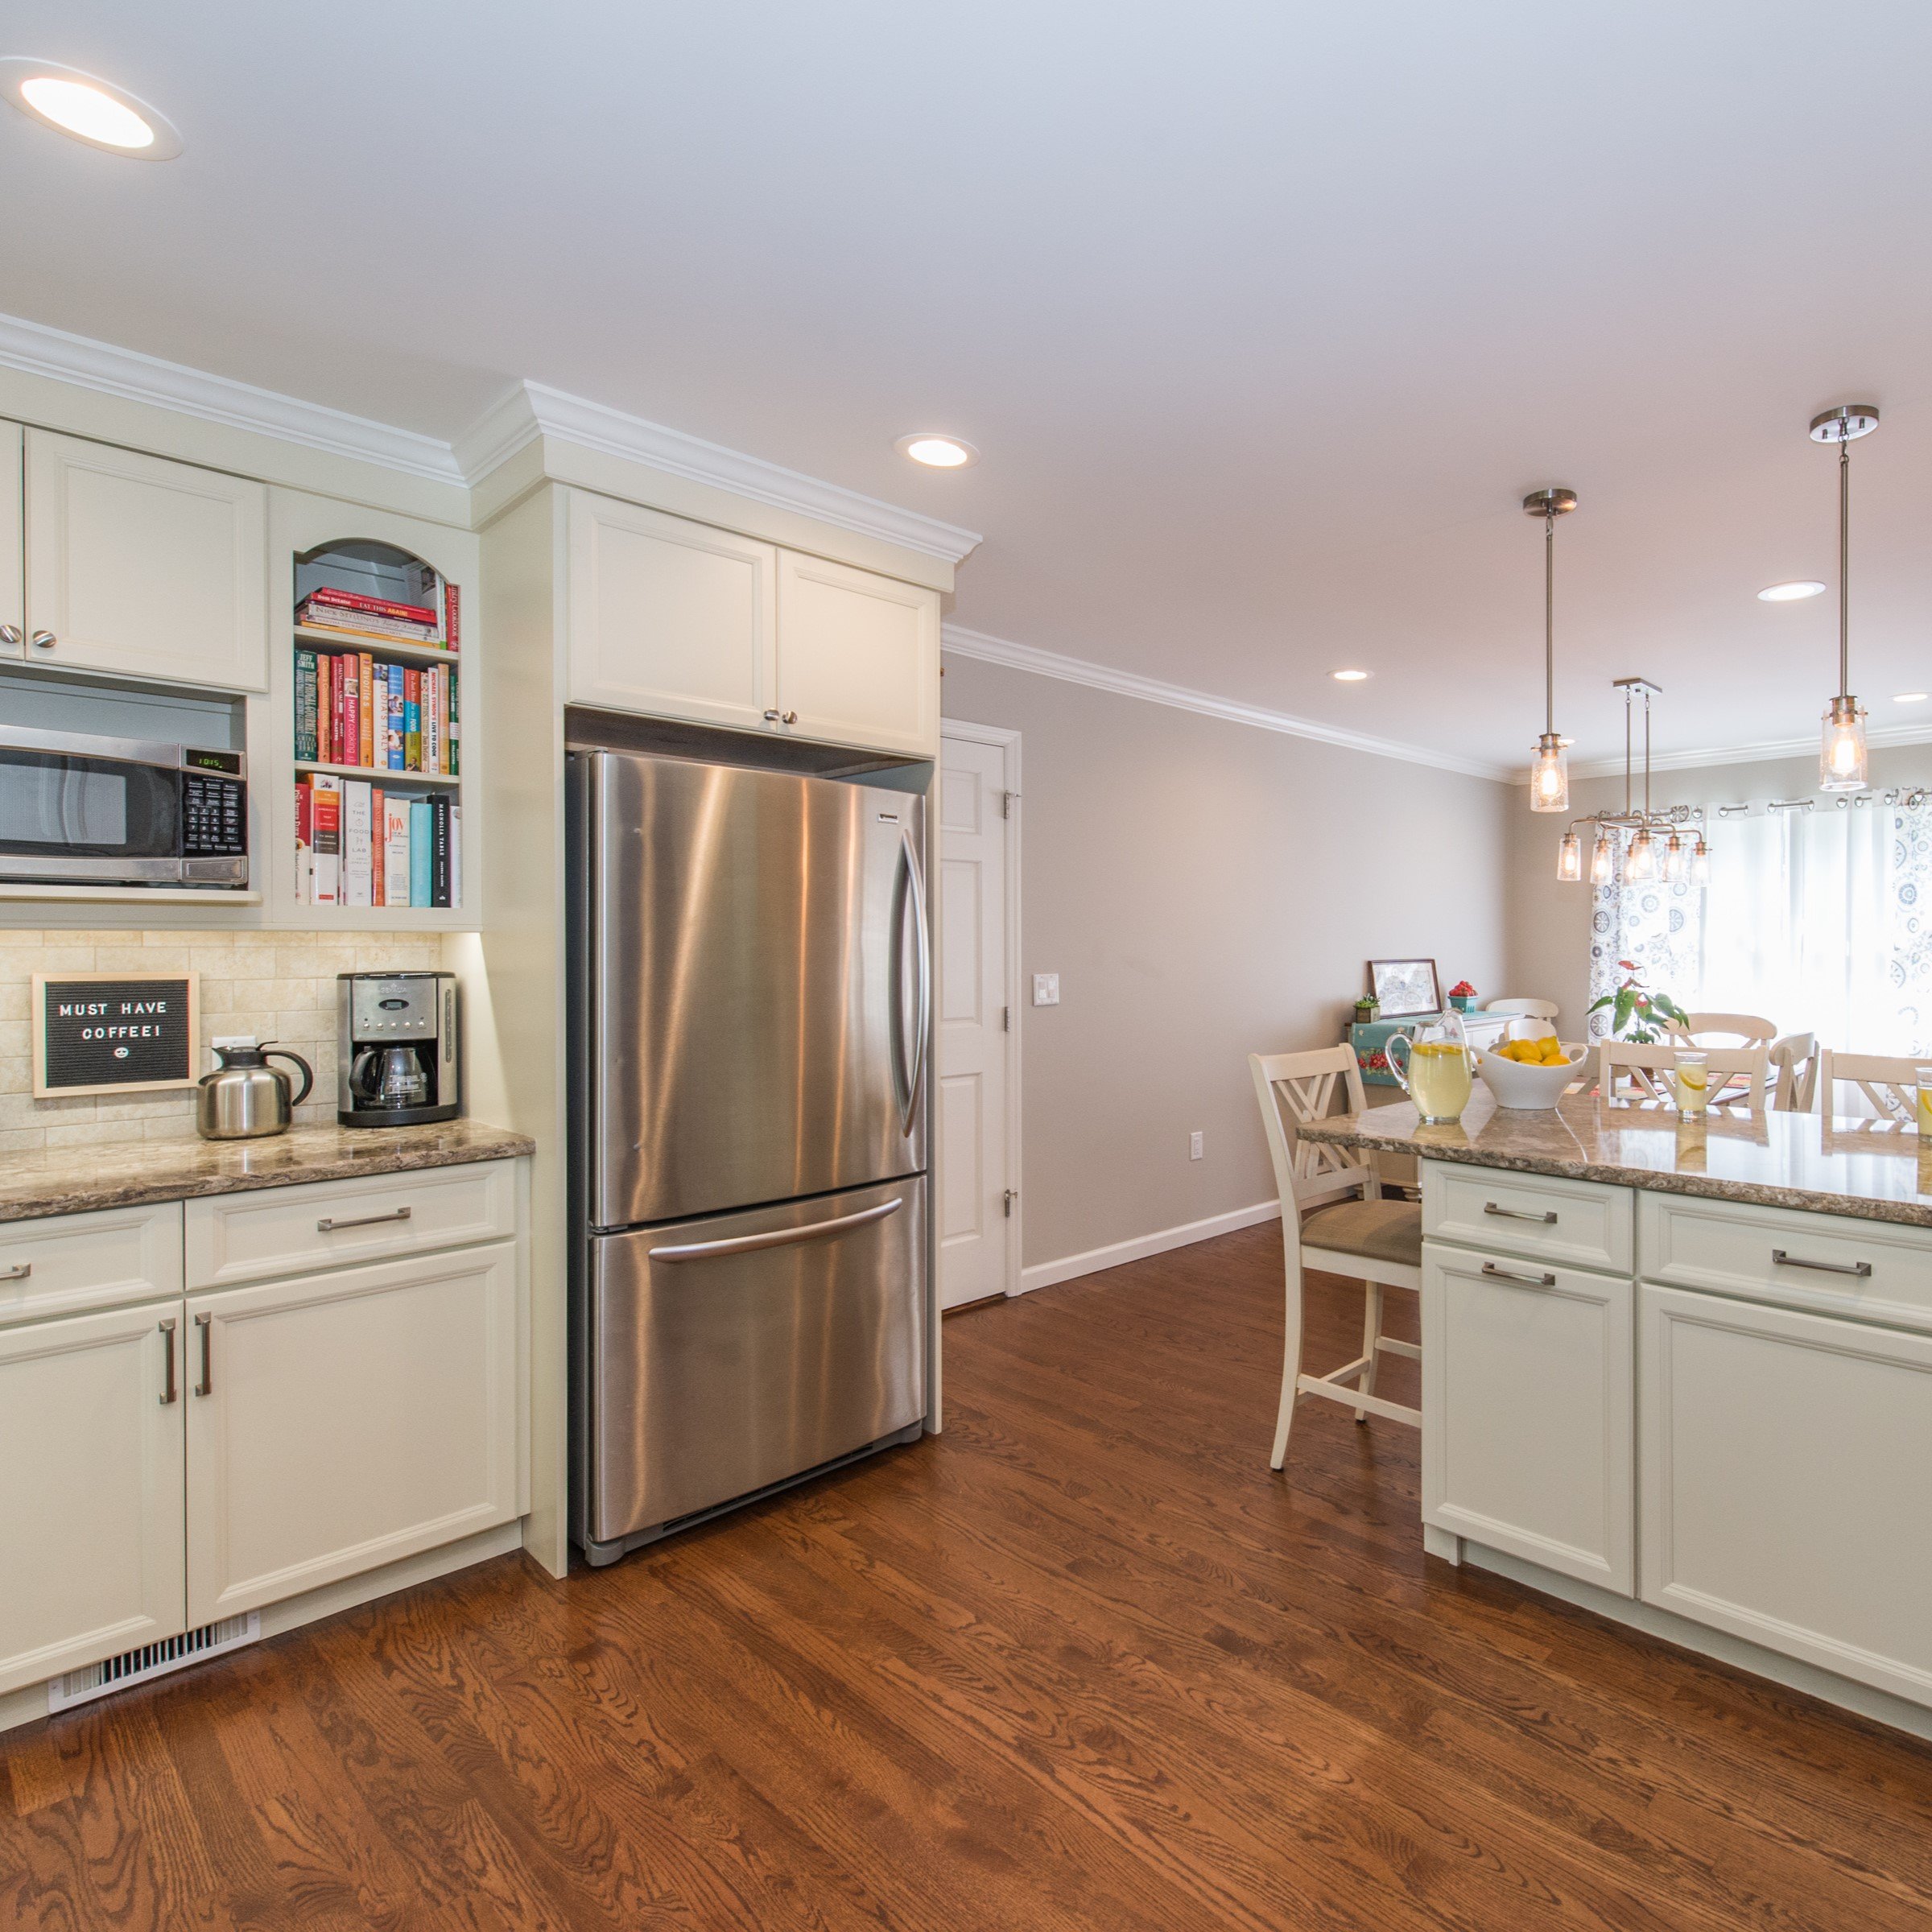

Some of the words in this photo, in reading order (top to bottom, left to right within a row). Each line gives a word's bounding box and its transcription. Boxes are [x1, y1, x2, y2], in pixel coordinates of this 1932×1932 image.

[299, 653, 313, 661] JEFF
[297, 660, 315, 669] SMITH
[305, 671, 316, 683] THE
[305, 683, 316, 706] FRUGAL
[305, 706, 316, 735] GOURMET
[385, 813, 404, 842] joy
[59, 1003, 107, 1016] MUST
[121, 1002, 166, 1014] HAVE
[82, 1025, 160, 1040] COFFEE!
